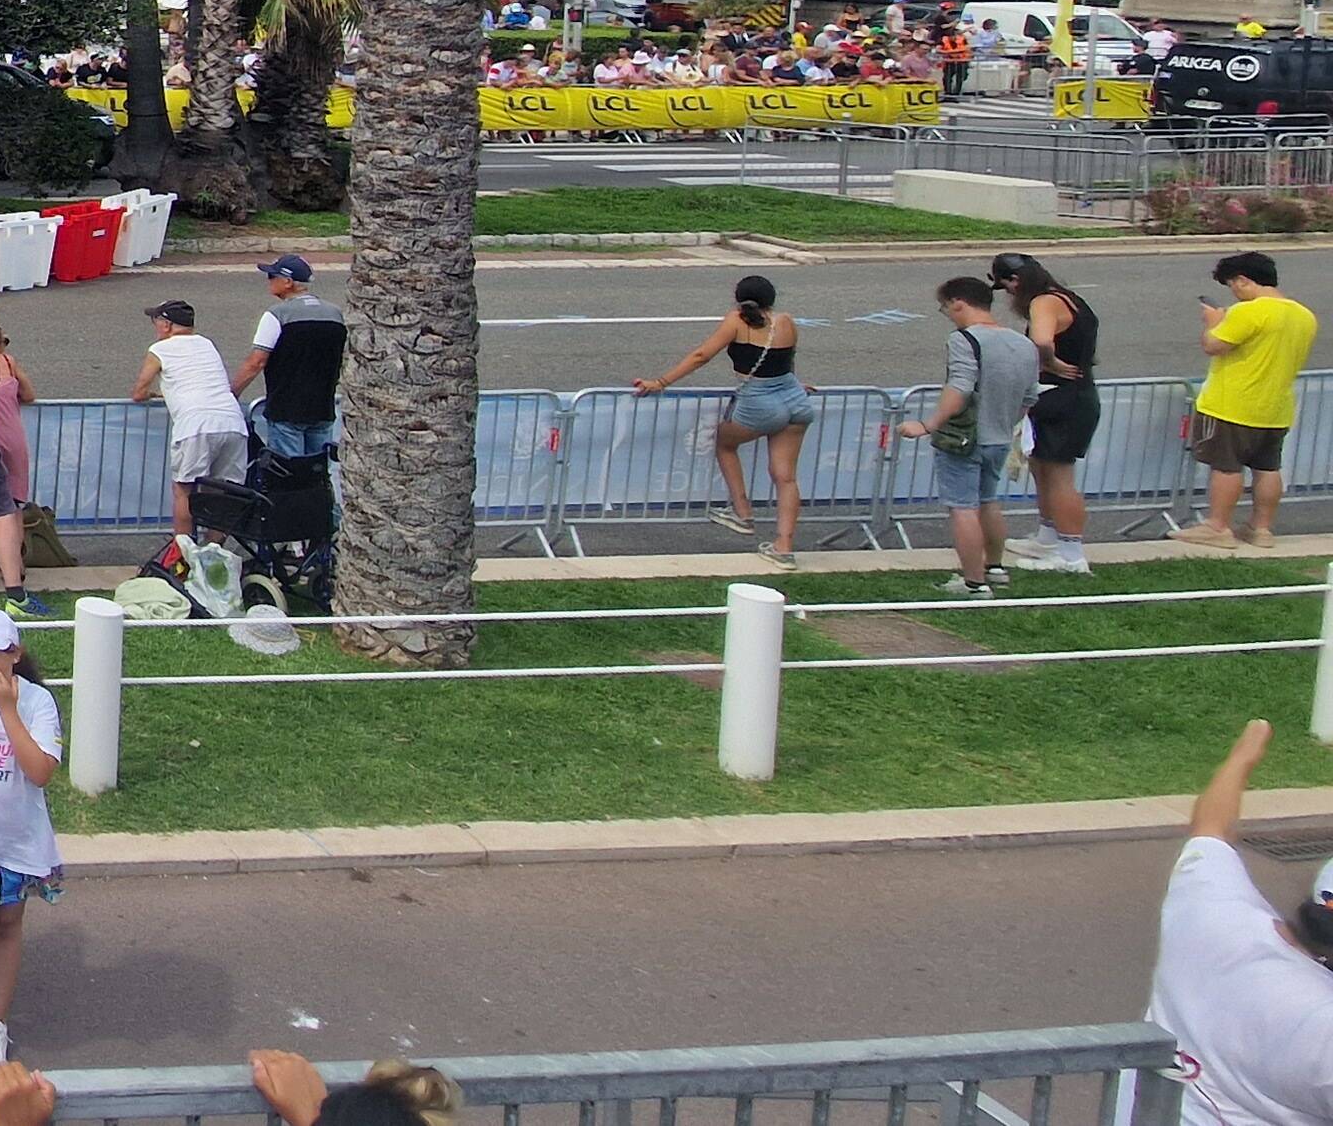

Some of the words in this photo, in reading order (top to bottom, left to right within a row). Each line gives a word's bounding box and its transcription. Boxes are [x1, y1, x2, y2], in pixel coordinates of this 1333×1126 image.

[1167, 55, 1223, 72] ARKEA
[507, 95, 556, 111] LCL
[591, 95, 641, 111] LCL
[668, 95, 713, 111] LCL
[749, 94, 797, 109] LCL
[826, 93, 872, 108] LCL
